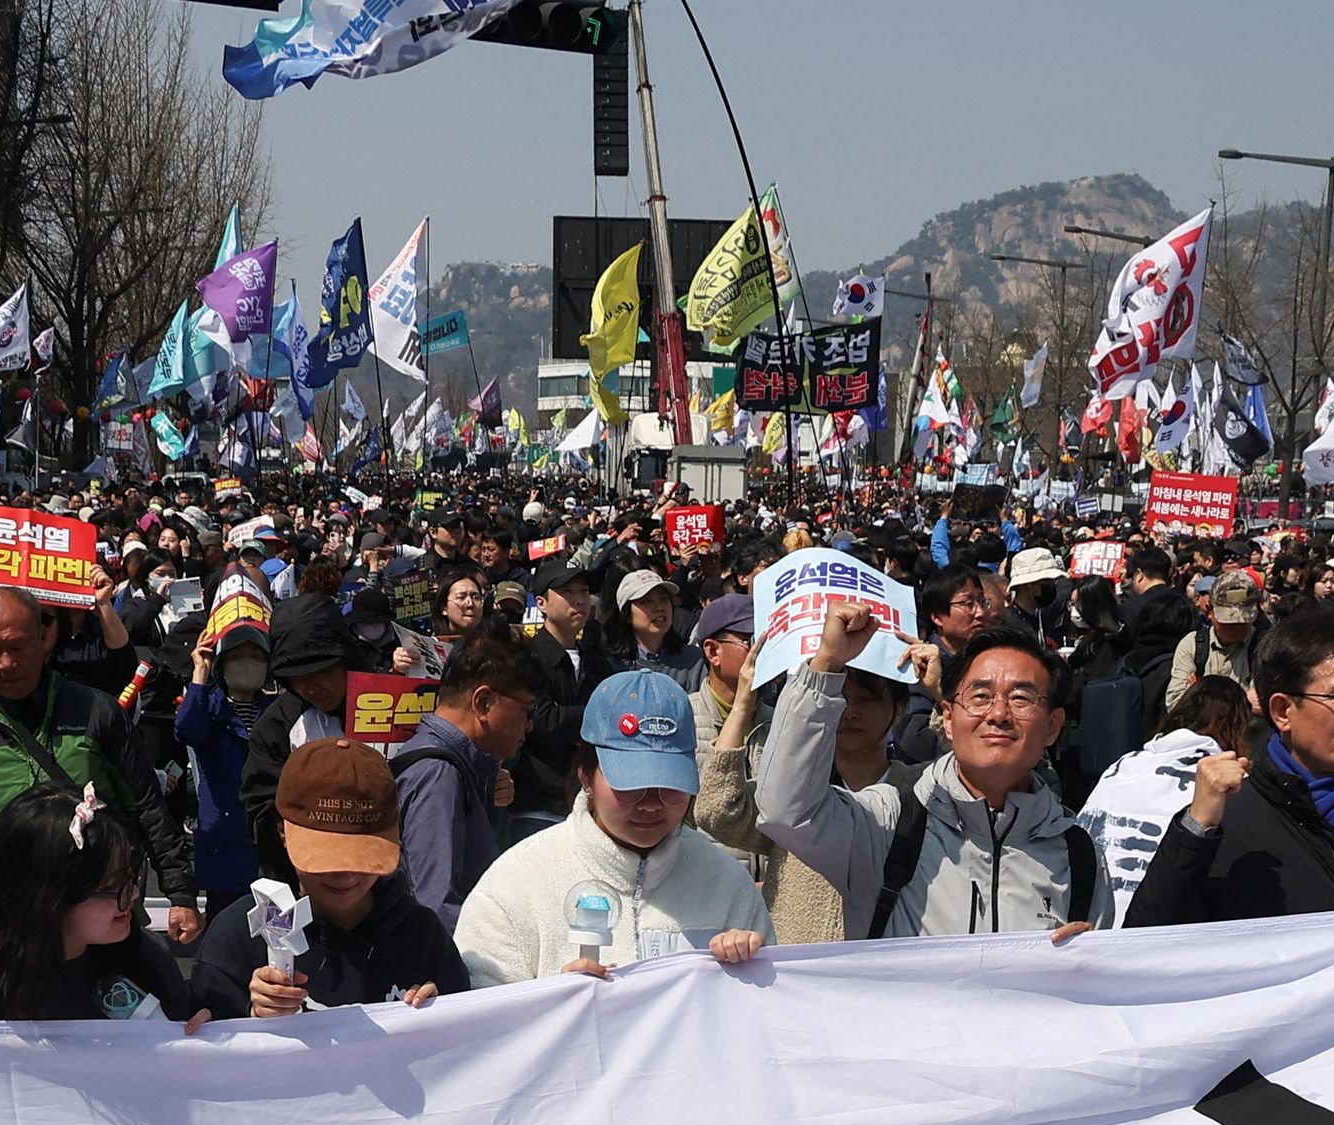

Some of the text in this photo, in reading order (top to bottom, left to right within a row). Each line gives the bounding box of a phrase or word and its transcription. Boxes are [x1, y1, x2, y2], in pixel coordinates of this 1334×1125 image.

[1153, 487, 1232, 504] 마침내 윤석열 파면
[1150, 503, 1231, 520] 새봄에는 새나라로
[675, 513, 708, 530] 윤석열
[673, 528, 715, 544] 즉각 구속
[28, 552, 92, 587] 파면!
[774, 561, 885, 604] 윤석열은
[317, 798, 375, 809] THIS IS NOT
[315, 811, 363, 823] VINTAGE
